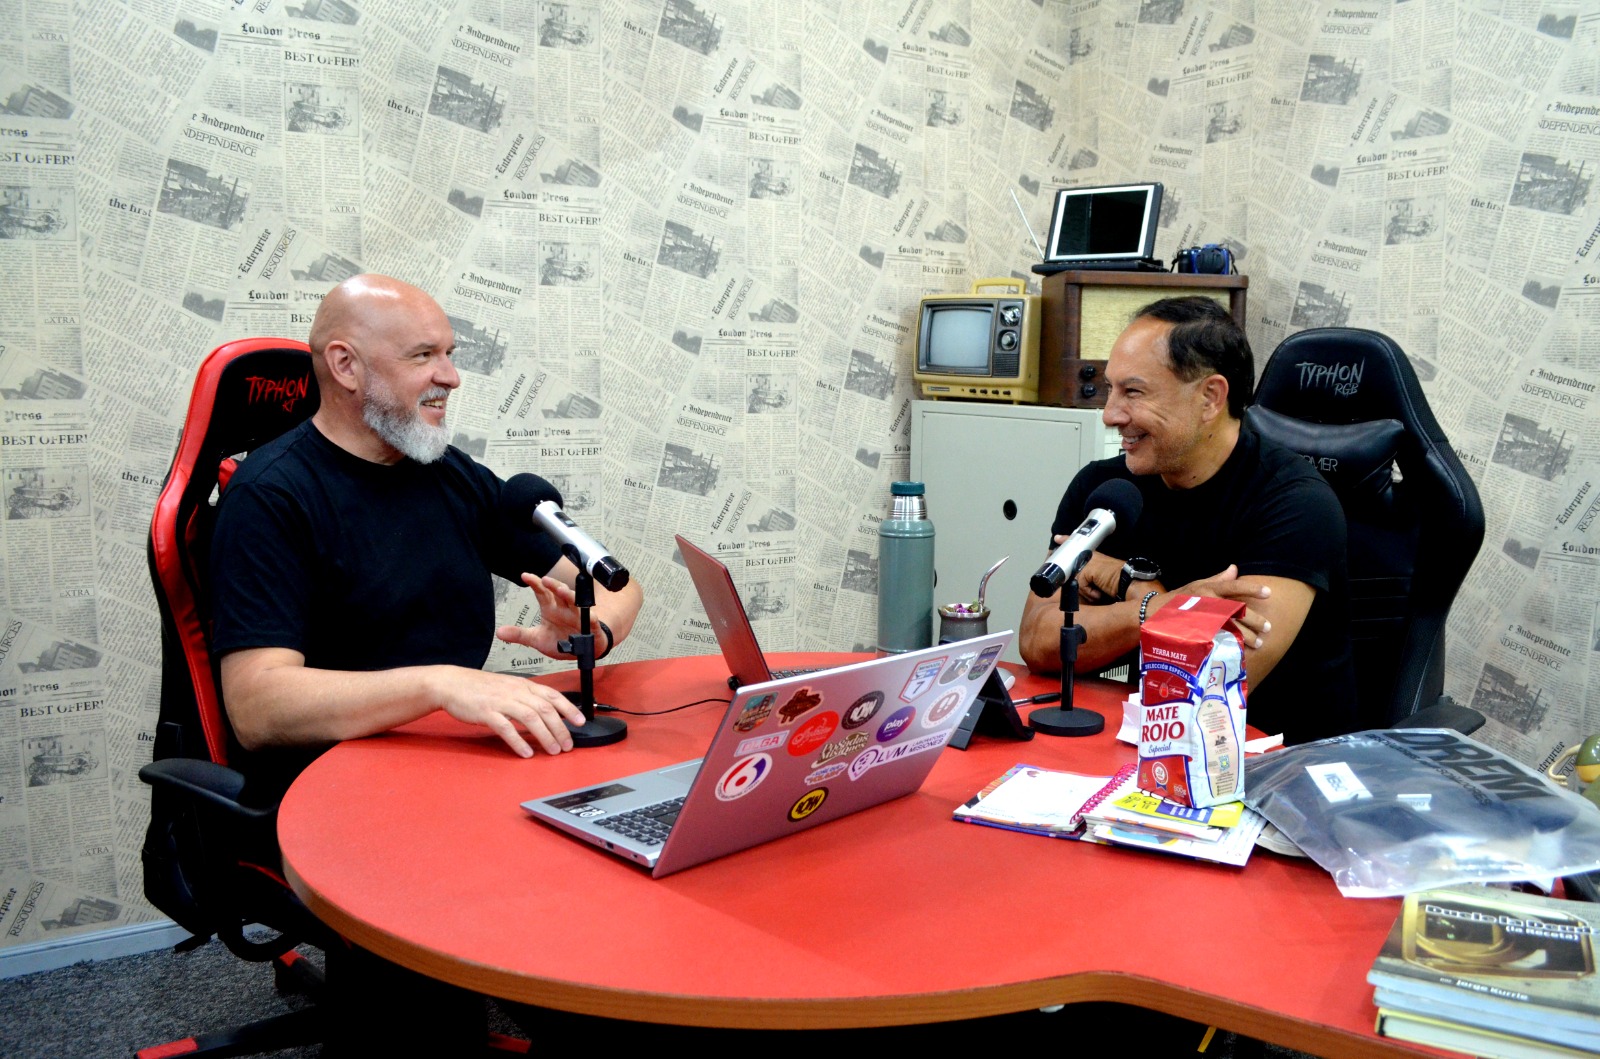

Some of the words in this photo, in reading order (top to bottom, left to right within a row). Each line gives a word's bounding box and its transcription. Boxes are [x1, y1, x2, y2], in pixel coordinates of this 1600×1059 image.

[284, 50, 314, 63] BEST
[387, 100, 402, 110] the
[749, 132, 773, 143] BEST
[1387, 169, 1411, 181] BEST
[108, 198, 126, 209] the
[539, 213, 563, 224] BEST
[747, 348, 767, 357] BEST
[1295, 357, 1365, 390] TYPHON
[245, 371, 309, 405] TYPHON
[1334, 383, 1359, 398] RGB
[1, 435, 36, 446] BEST
[541, 447, 564, 457] BEST
[745, 559, 765, 567] BEST
[1152, 647, 1169, 657] YERBA
[1171, 651, 1187, 661] MATE
[1169, 665, 1191, 682] ESPECIAL
[913, 681, 925, 695] 7
[20, 705, 51, 718] BEST
[1146, 705, 1179, 722] MATE
[138, 732, 154, 742] the
[1141, 721, 1185, 743] ROJO
[877, 745, 908, 763] LVM
[1148, 742, 1172, 754] Especial
[1456, 980, 1488, 991] Jorge
